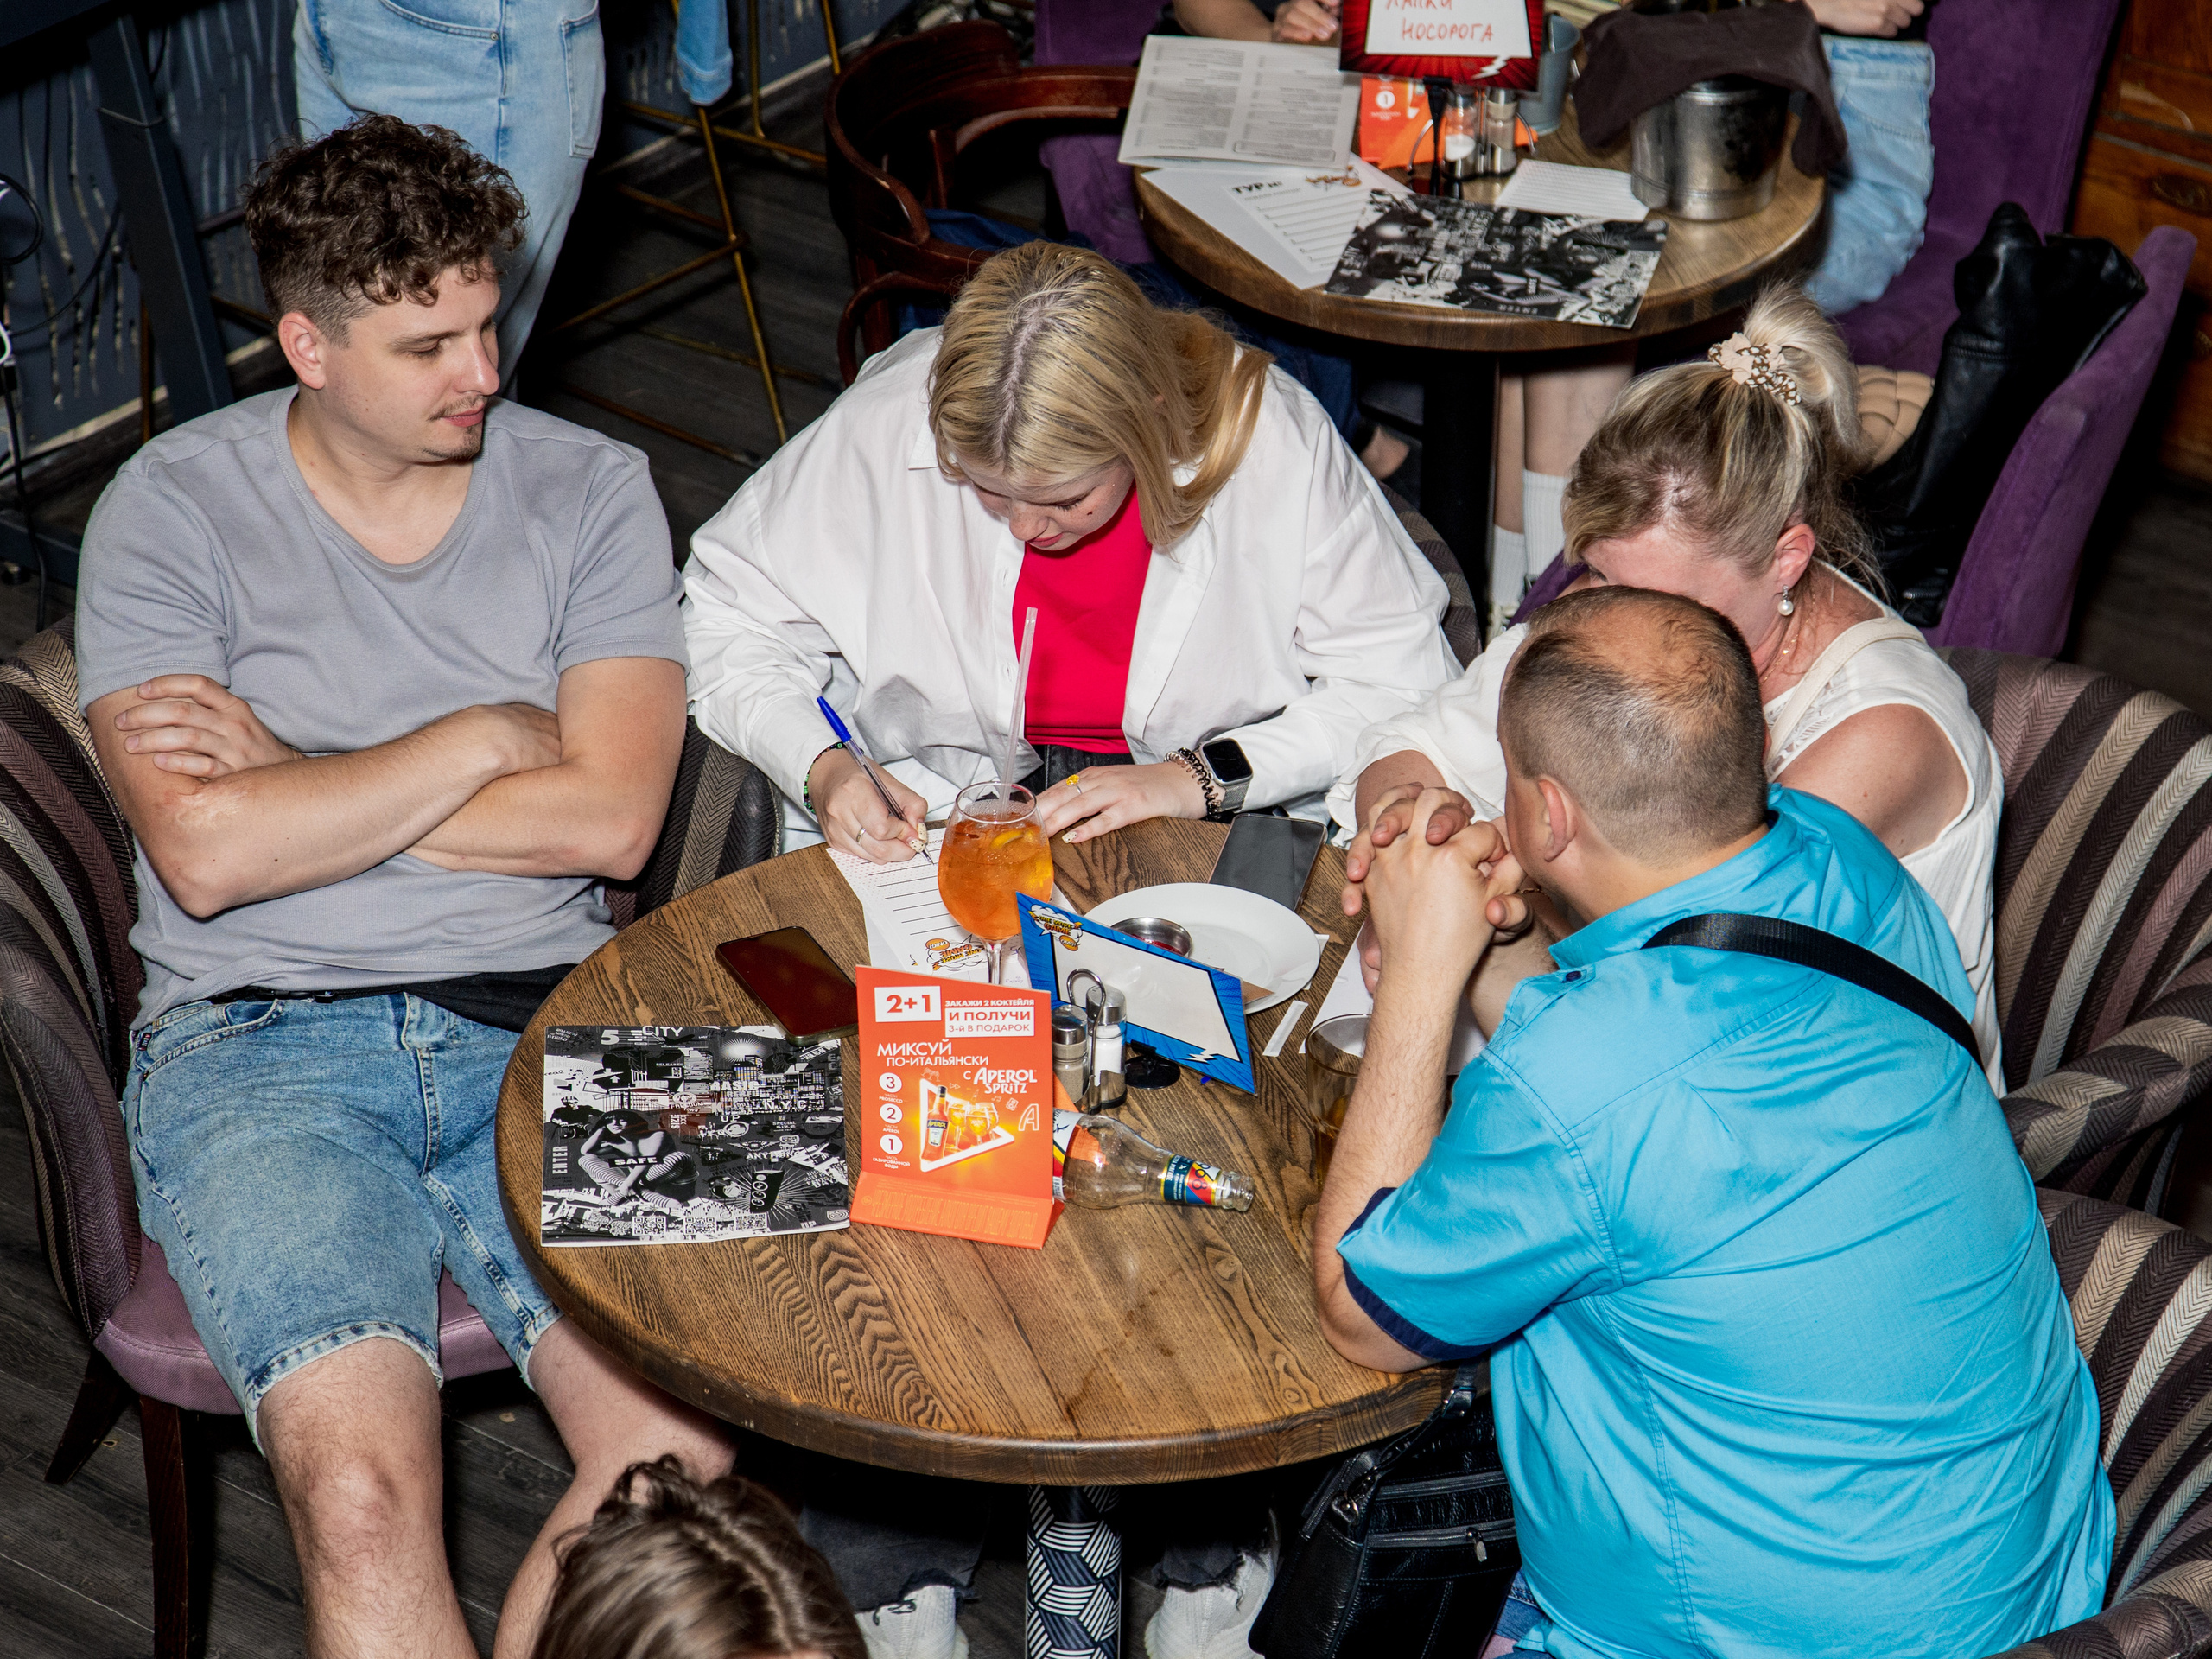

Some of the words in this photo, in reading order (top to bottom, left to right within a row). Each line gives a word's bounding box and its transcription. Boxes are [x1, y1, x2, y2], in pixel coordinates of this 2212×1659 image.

[1402, 17, 1495, 42] НОСОРОГА
[1044, 922, 1071, 937] GAME
[939, 944, 973, 958] GAME
[940, 953, 965, 963] MORE
[887, 994, 931, 1014] 2+1
[949, 1012, 959, 1021] И
[964, 1011, 1031, 1021] ПОЛУЧИ
[642, 1025, 683, 1037] CITY
[976, 1024, 1030, 1033] ПОДАРОК
[601, 1029, 620, 1046] 5
[877, 1039, 952, 1057] МИКСУЙ
[887, 1056, 989, 1067] ПО-ИТАЛЬЯНСКИ
[973, 1067, 1037, 1085] APEROL
[886, 1077, 895, 1090] 3
[887, 1107, 896, 1120] 2
[888, 1138, 893, 1151] 1
[553, 1146, 568, 1174] ENTER
[614, 1157, 658, 1166] SAFE
[873, 1157, 911, 1166] ГАЗИРОВАННОЙ
